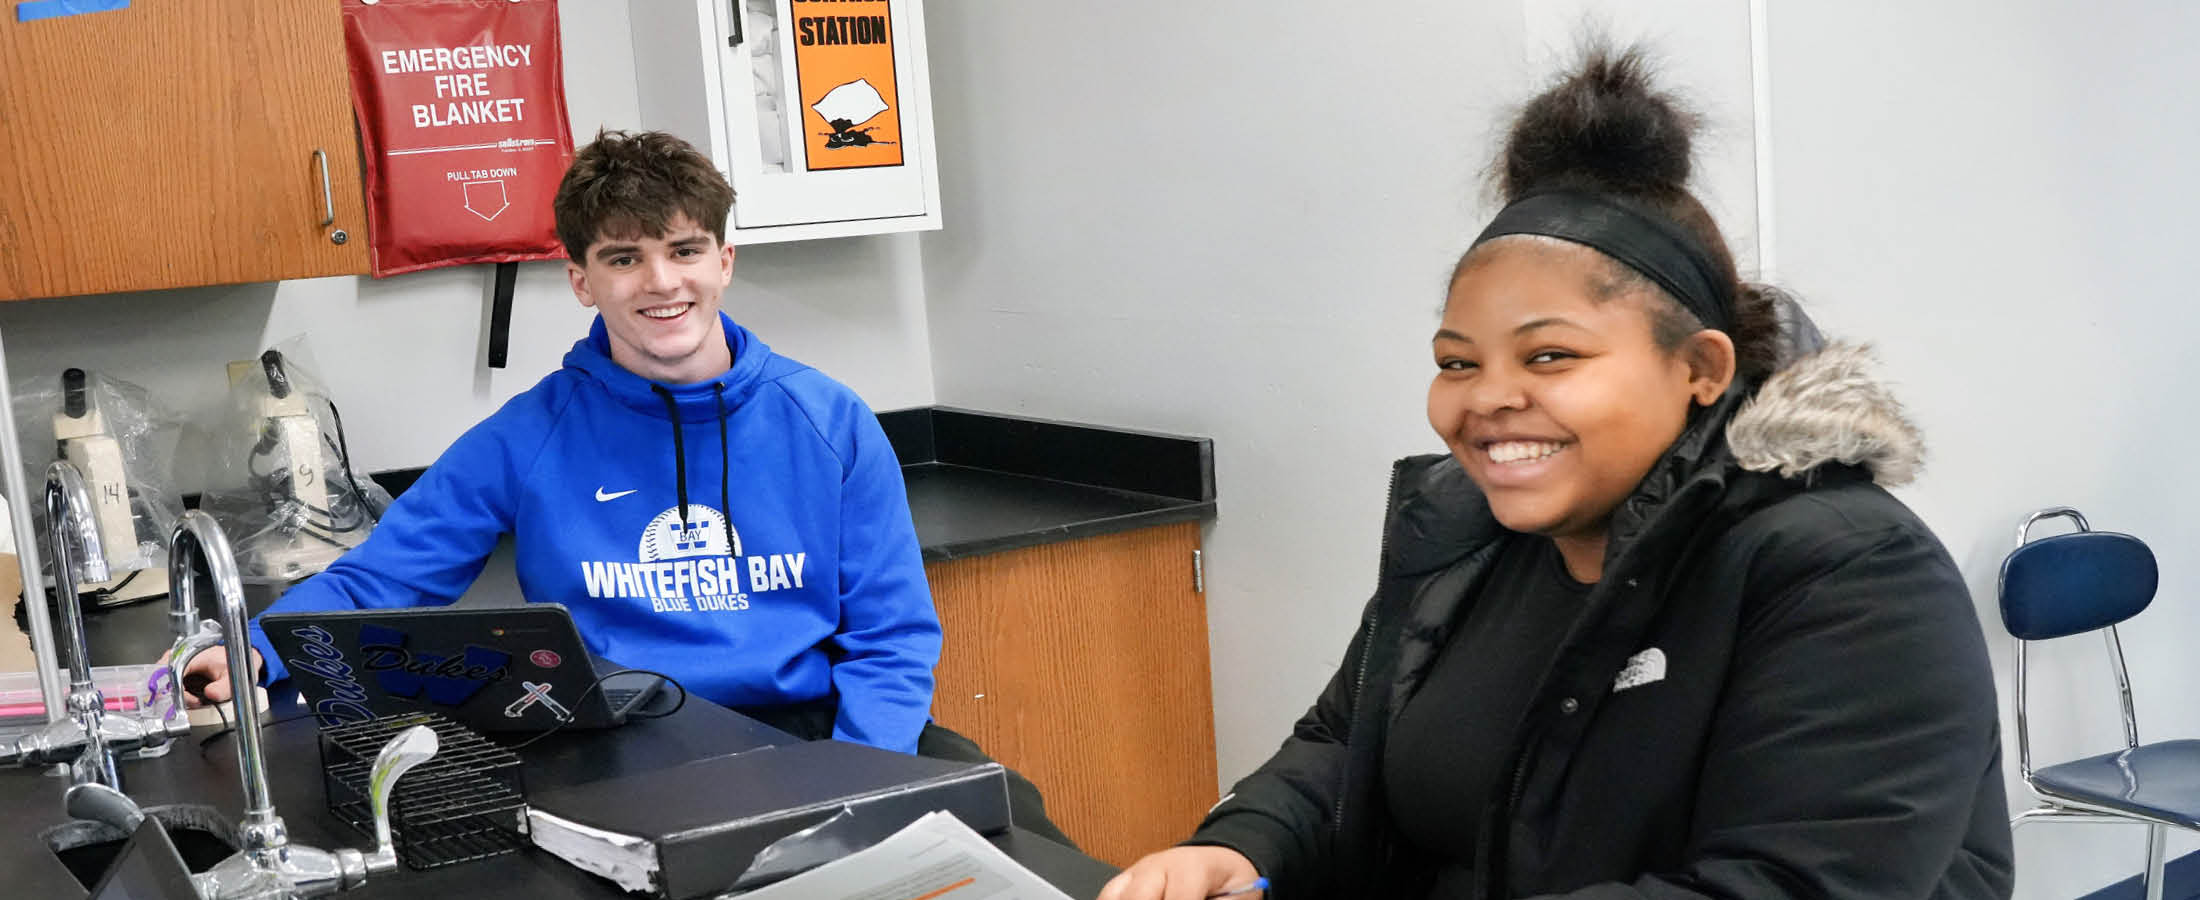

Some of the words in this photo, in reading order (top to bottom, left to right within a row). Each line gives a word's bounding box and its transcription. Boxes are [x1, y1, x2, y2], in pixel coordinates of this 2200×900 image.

[799, 16, 886, 46] STATION
[382, 44, 532, 74] EMERGENCY
[435, 73, 490, 98] FIRE
[412, 98, 525, 128] BLANKET
[447, 171, 470, 181] PULL
[470, 169, 488, 179] TAB
[490, 167, 517, 178] DOWN
[103, 484, 120, 505] 14
[680, 530, 702, 542] BAY
[581, 557, 739, 599] WHITEFISH
[747, 552, 806, 593] BAY
[652, 597, 692, 613] BLUE
[697, 593, 750, 612] DUKES
[288, 625, 378, 728] Dukes
[360, 644, 513, 682] Dukes
